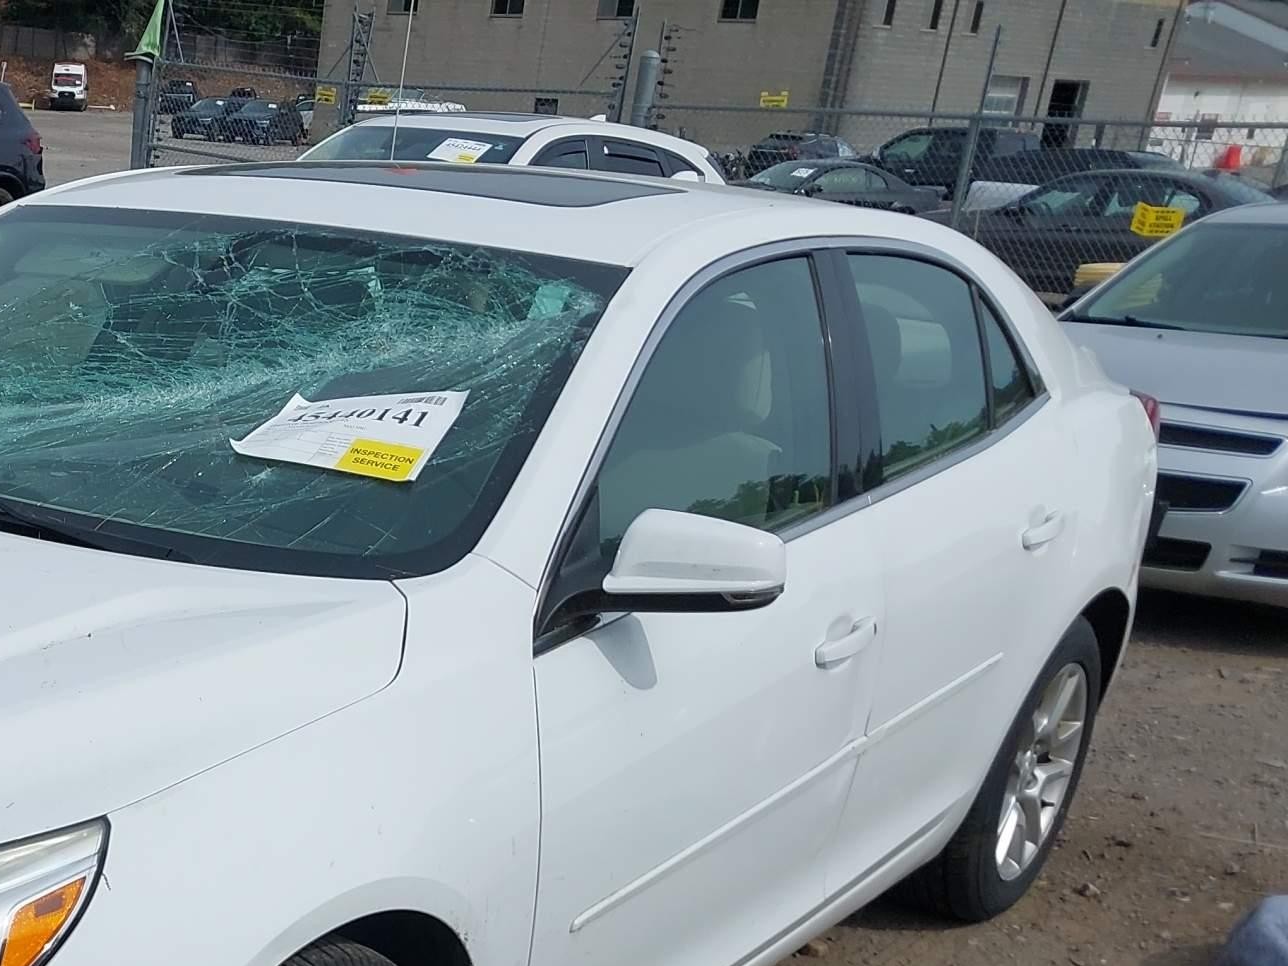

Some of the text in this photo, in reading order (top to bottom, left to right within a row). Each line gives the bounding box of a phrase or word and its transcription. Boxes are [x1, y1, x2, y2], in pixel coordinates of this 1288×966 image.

[287, 407, 429, 428] 45440141
[349, 446, 415, 465] INSPECTION
[351, 456, 401, 472] SERVICE
